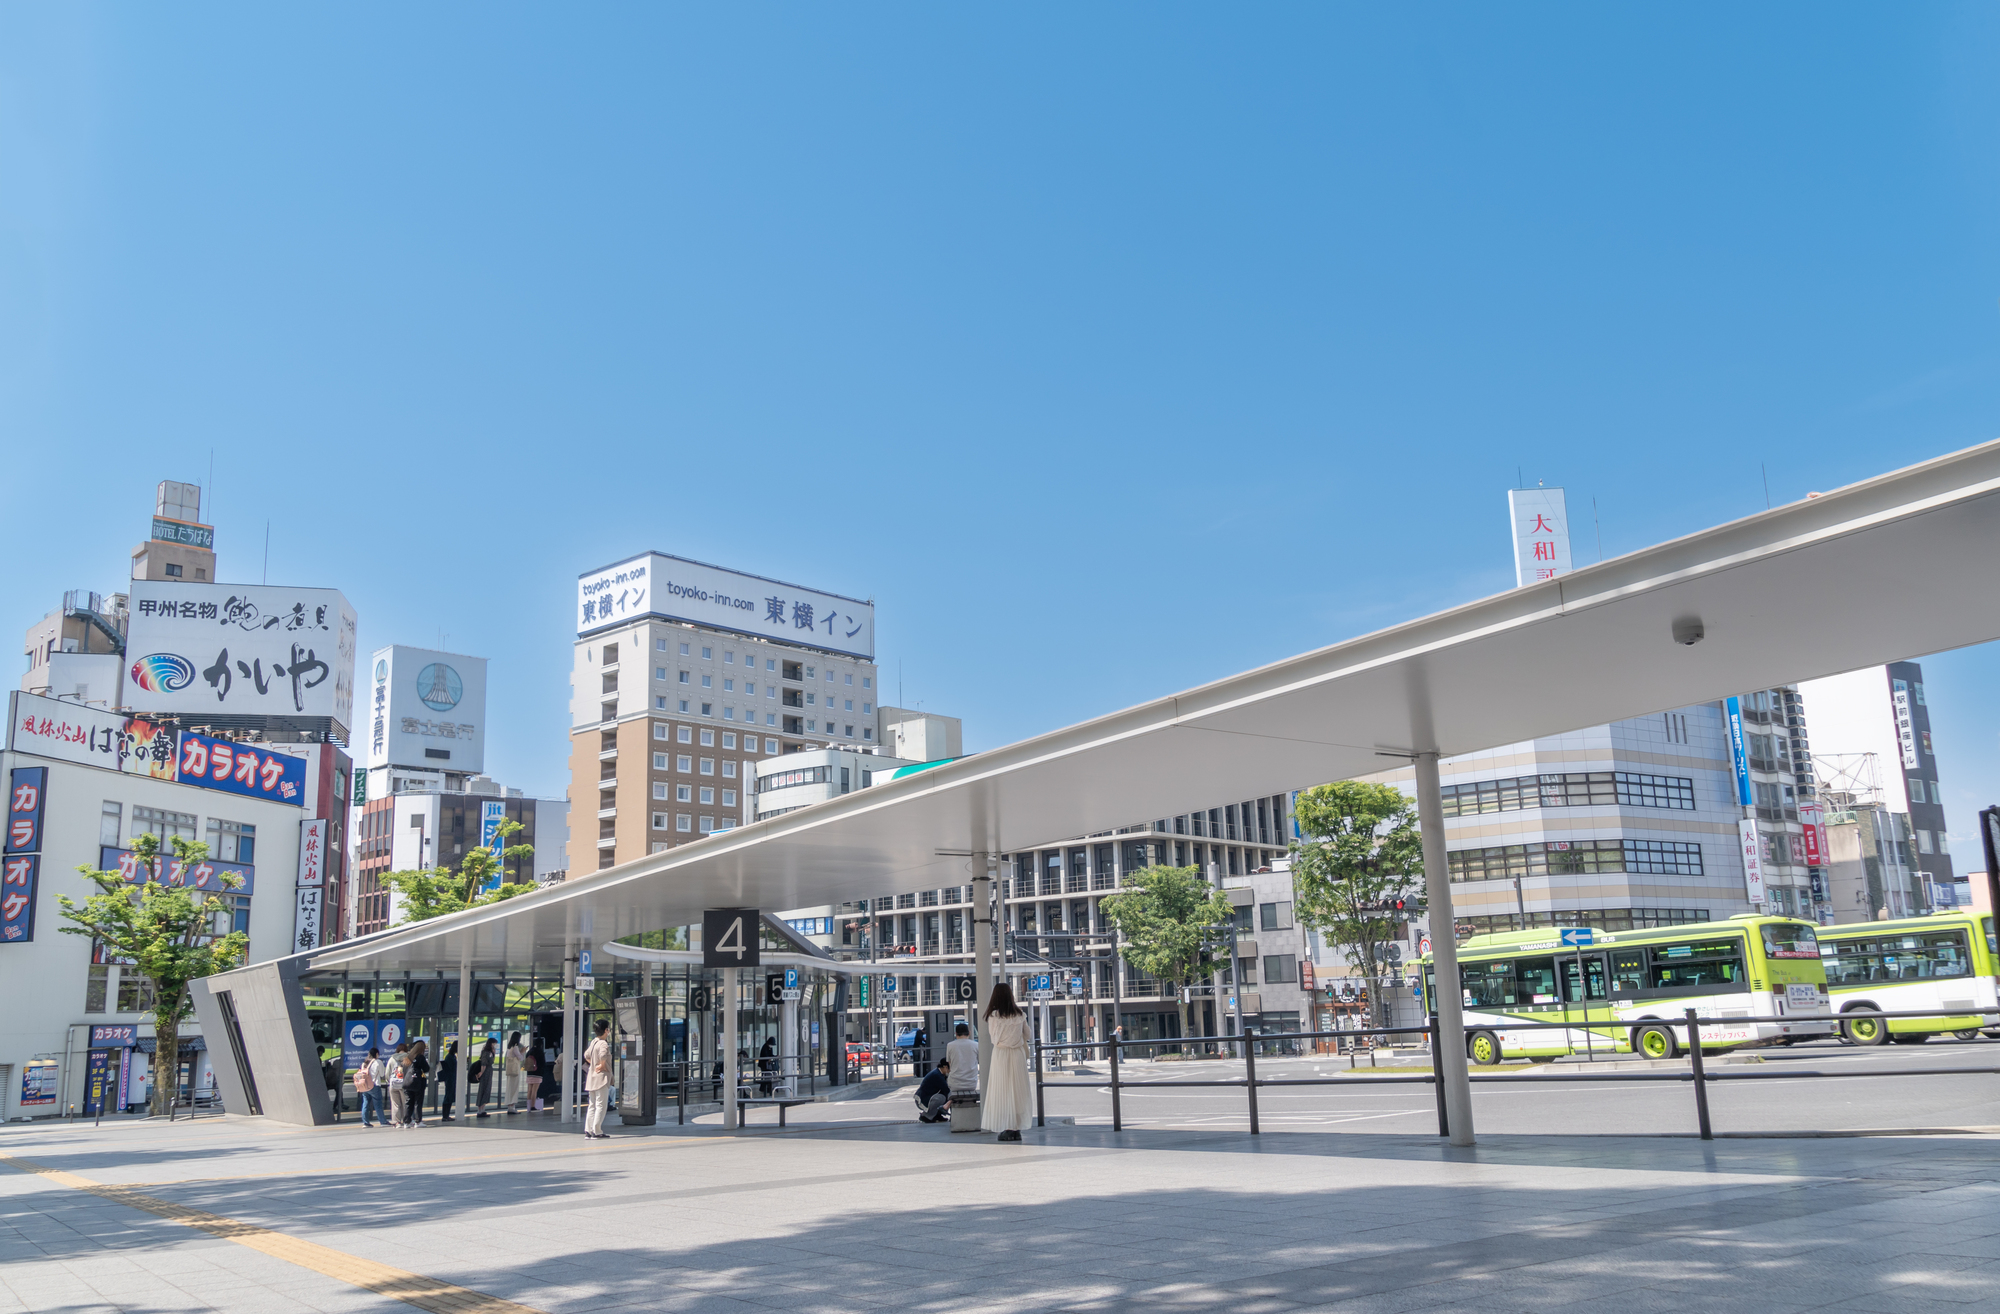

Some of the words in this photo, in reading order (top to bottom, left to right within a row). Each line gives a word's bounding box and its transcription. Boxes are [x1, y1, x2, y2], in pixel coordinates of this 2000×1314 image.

[153, 526, 176, 540] HOTEL
[178, 527, 212, 546] たちばな
[582, 566, 646, 596] toyoko-inn.com
[138, 600, 217, 619] 甲州名物
[581, 588, 645, 625] 東横イン
[667, 580, 754, 612] toyoko-inn.com
[764, 595, 863, 638] 東横イン
[203, 641, 330, 712] かいや
[401, 716, 474, 740] 富士急行
[1896, 694, 1915, 765] 駅前銀座ビル
[21, 715, 87, 745] 風林火山
[89, 725, 174, 770] はなの舞
[181, 738, 285, 792] カラオケ
[487, 803, 503, 817] jit
[2, 783, 38, 921] カラオケ
[304, 824, 319, 880] 風林火山
[1743, 831, 1760, 883] 大和証券
[298, 892, 317, 951] はなの舞
[715, 917, 746, 960] 4
[1519, 942, 1558, 951] YAMANASHI
[582, 952, 590, 971] P
[772, 977, 783, 1001] 5
[788, 971, 796, 986] P
[886, 978, 895, 990] P
[960, 980, 972, 999] 6
[1040, 977, 1048, 988] P
[94, 1027, 132, 1040] カラオケ
[1701, 1031, 1747, 1040] ンステップバス
